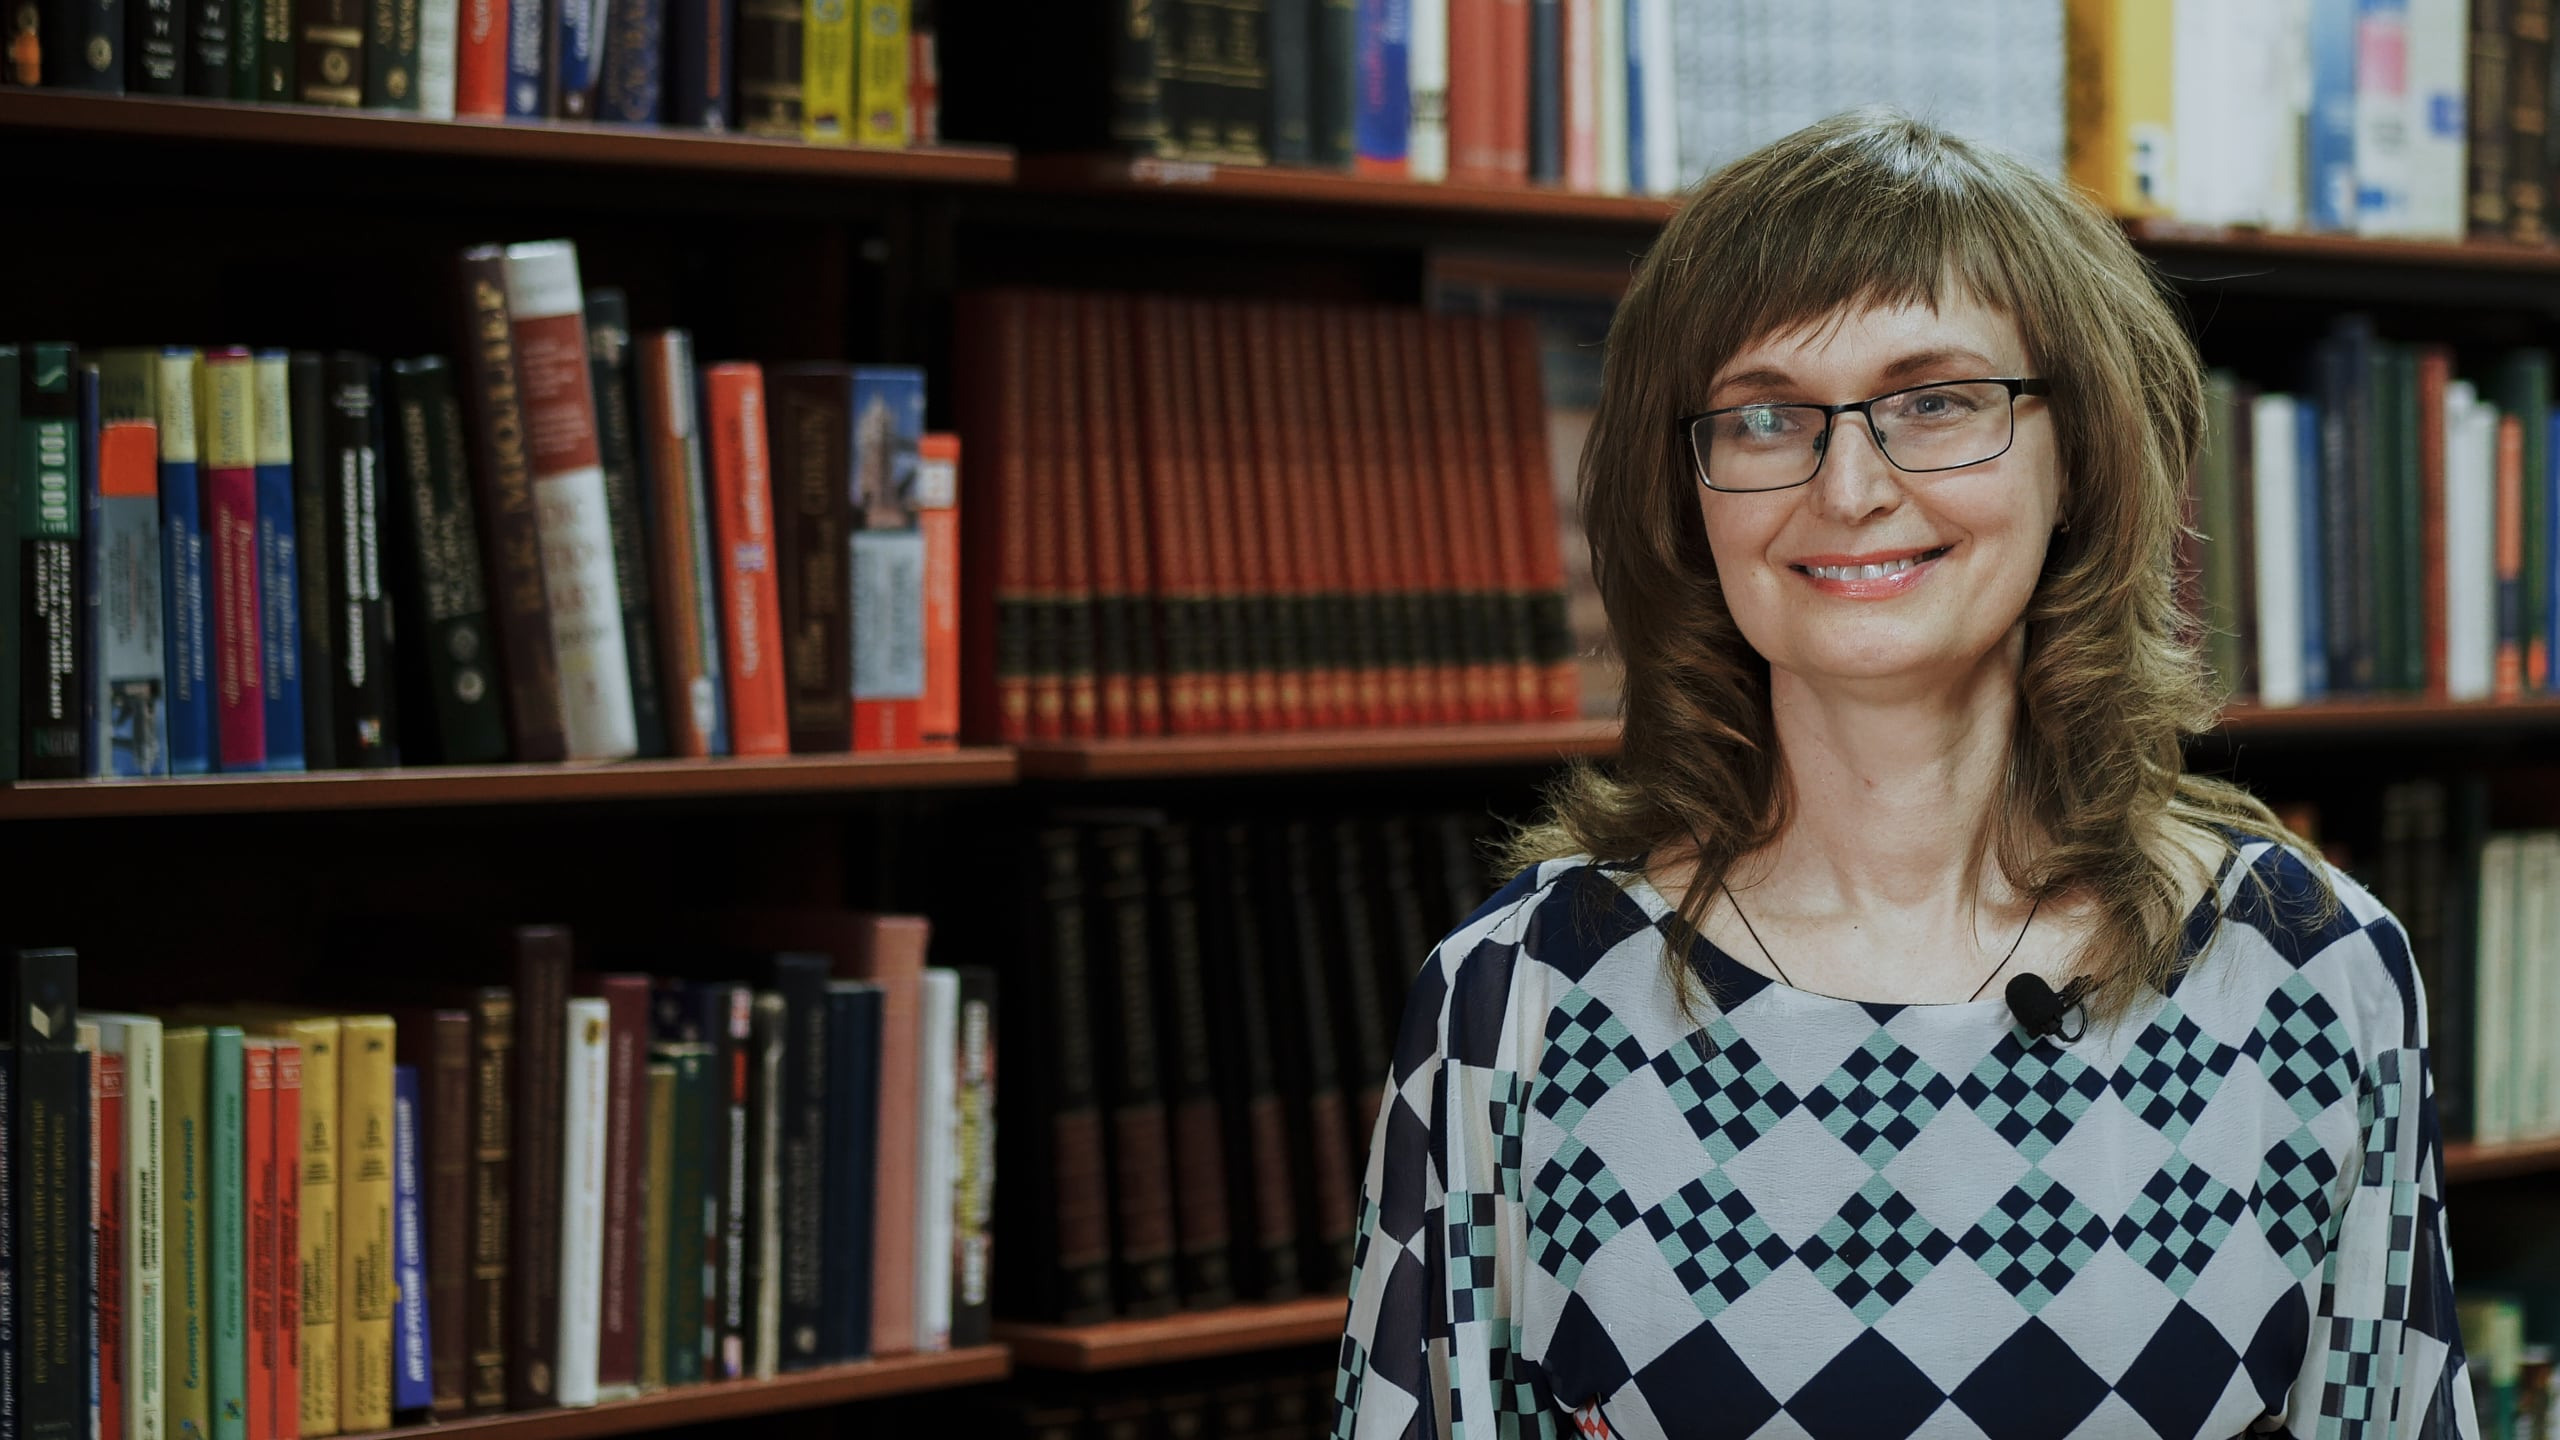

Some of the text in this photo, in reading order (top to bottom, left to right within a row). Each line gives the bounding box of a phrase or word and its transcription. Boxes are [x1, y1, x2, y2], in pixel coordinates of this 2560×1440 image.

[39, 421, 68, 522] 100 000
[35, 540, 50, 618] СЛОВАРЬ
[49, 540, 64, 720] РУССКО-АНГЛИЙСКИЙ
[61, 540, 75, 676] АНГЛО-РУССКИЙ
[397, 1096, 425, 1382] АНГЛО-РУССКИЙ СЛОВАРЬ СОКРАЩЕНИЙ
